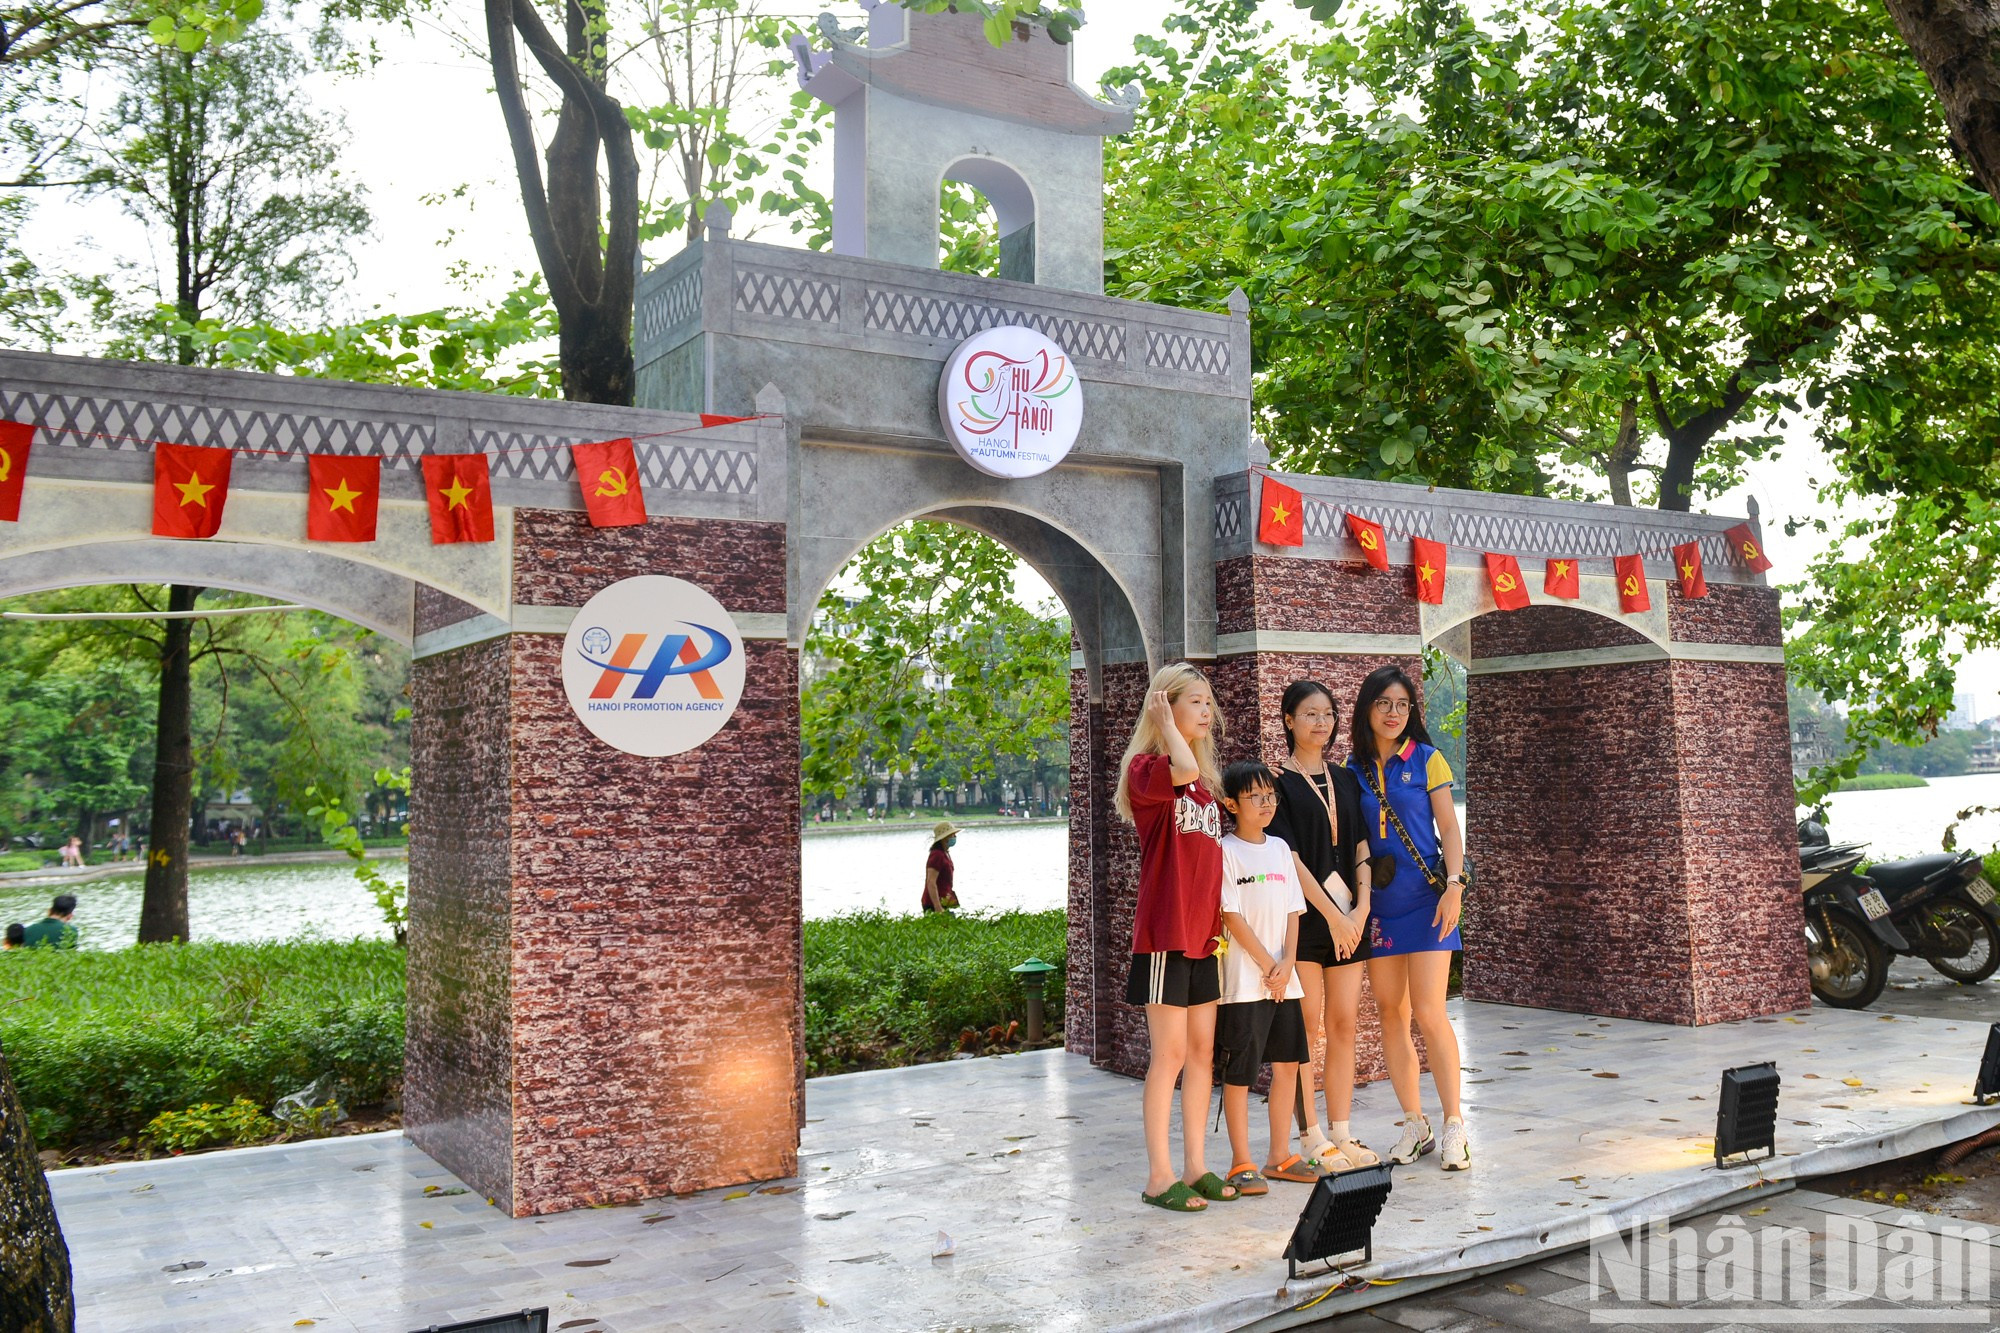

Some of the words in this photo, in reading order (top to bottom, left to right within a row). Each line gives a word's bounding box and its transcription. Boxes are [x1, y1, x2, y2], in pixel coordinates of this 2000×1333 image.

[978, 436, 1011, 449] HANOI
[979, 448, 1016, 459] AUTUMN
[1017, 451, 1052, 462] FESTIVAL
[588, 702, 621, 711] HANOI
[623, 702, 683, 711] PROMOTION
[686, 702, 724, 711] AGENCY
